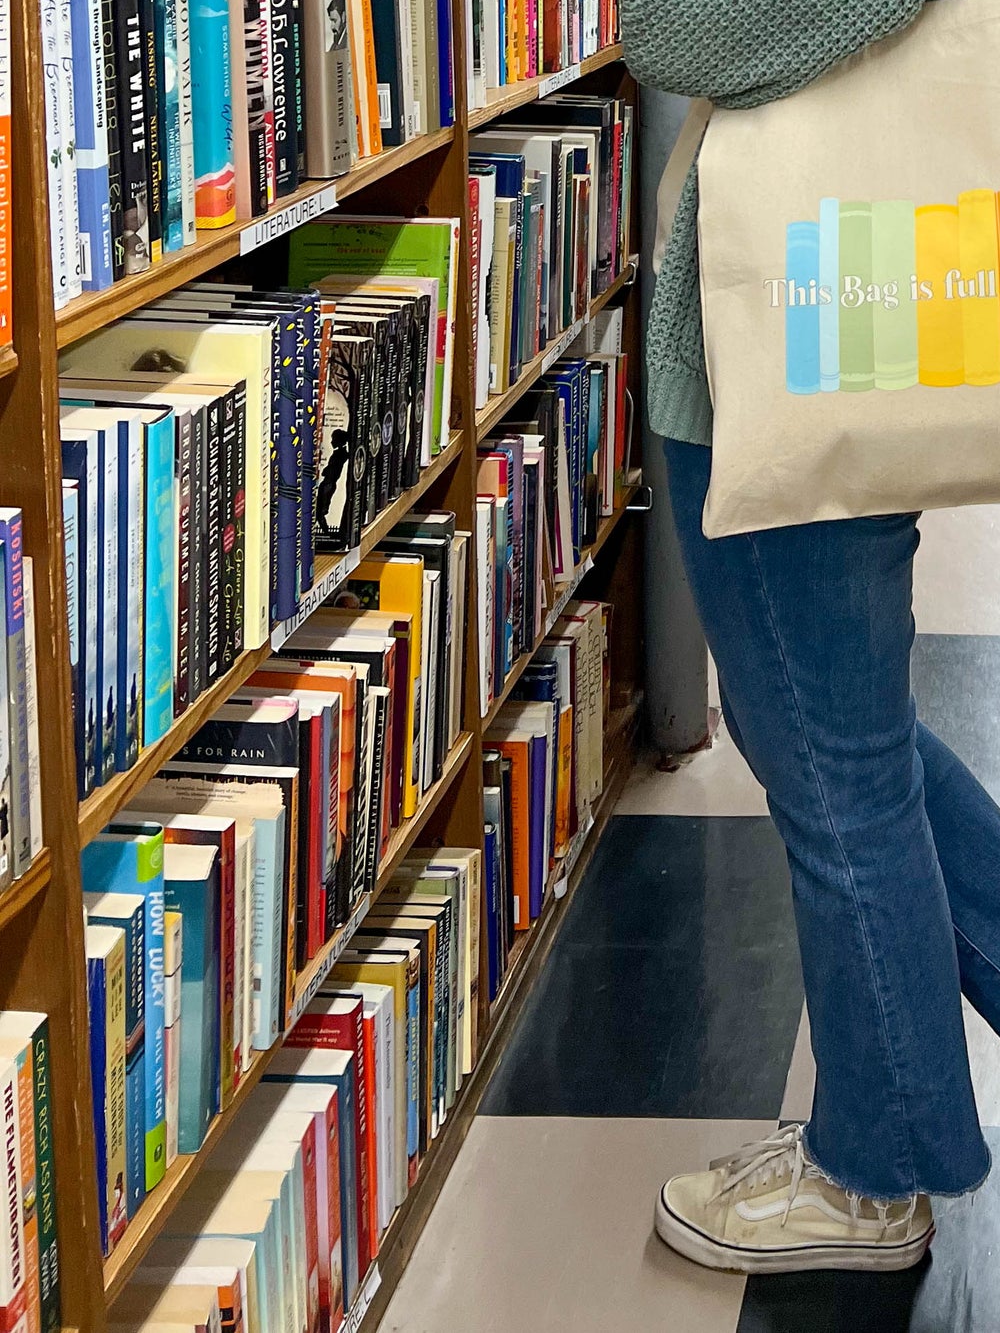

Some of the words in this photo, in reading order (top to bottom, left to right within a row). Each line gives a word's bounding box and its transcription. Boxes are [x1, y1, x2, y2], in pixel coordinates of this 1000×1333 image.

[94, 8, 102, 55] through
[127, 13, 141, 62] THE
[222, 25, 230, 97] SOMETHING
[129, 71, 146, 154] WHITE
[182, 57, 193, 126] WALK
[272, 34, 288, 142] Lawrence
[0, 134, 8, 293] redeployment
[255, 197, 319, 246] LITERATURE:
[320, 198, 325, 212] L
[764, 278, 832, 307] This
[840, 274, 900, 309] Bag
[909, 277, 934, 301] is
[943, 268, 998, 300] full
[312, 301, 322, 370] HARPER
[181, 423, 190, 497] BROKEN
[262, 367, 270, 511] Mockingbird
[208, 436, 219, 516] CHANG-RAE
[181, 506, 190, 584] SUMMER
[208, 519, 218, 544] LEE
[284, 565, 344, 638] LITERATURE:
[344, 557, 351, 574] L
[179, 642, 188, 678] LEE
[198, 746, 224, 757] FOR
[231, 748, 266, 759] RAIN
[150, 891, 164, 937] HOW
[149, 947, 164, 1009] LUCKY
[34, 1038, 47, 1099] CRAZY
[3, 1080, 14, 1122] THE
[38, 1106, 48, 1155] RICH
[6, 1123, 20, 1291] FLAMETHROWERS
[41, 1159, 53, 1234] ASIANS
[40, 1249, 50, 1301] KWAN
[50, 1238, 58, 1289] KEVIN
